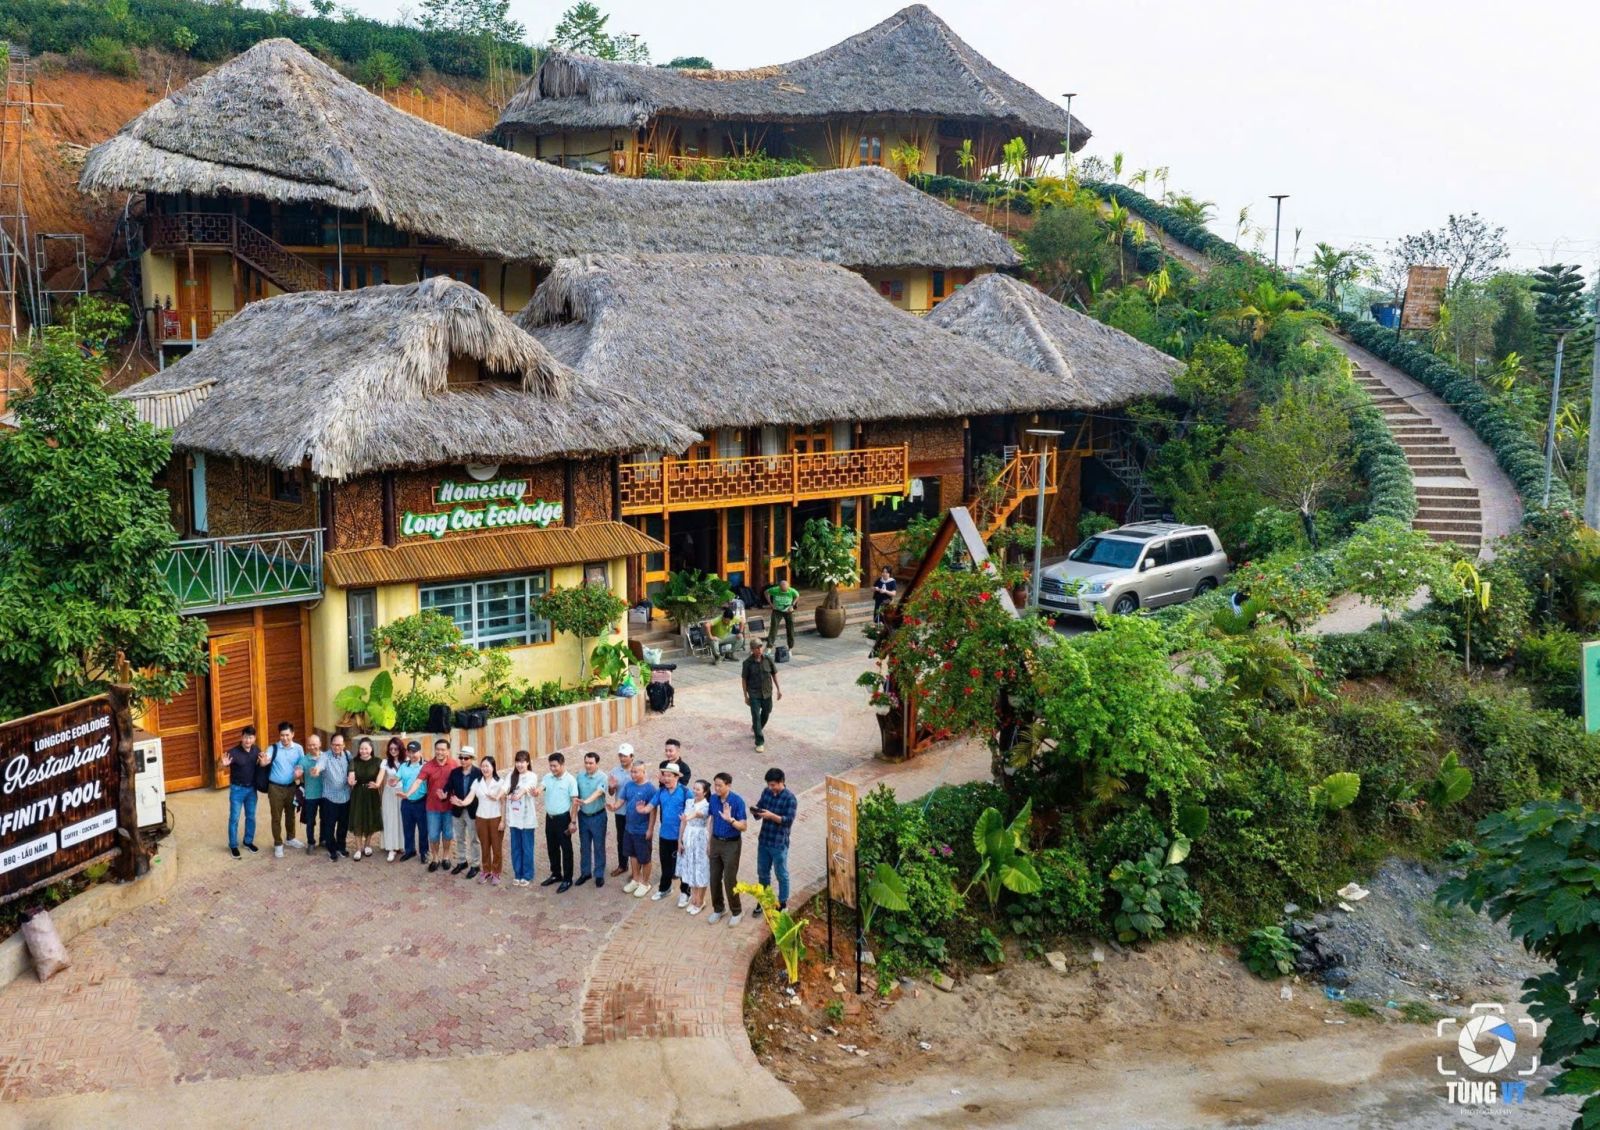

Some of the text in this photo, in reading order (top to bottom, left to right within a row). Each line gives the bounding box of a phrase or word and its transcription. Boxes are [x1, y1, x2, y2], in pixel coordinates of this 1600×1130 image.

[440, 480, 526, 501] Homestay
[403, 501, 563, 536] Long Coc Ecolodge
[34, 715, 110, 752] LONGCOC ECOLODGE
[3, 734, 111, 794] Restaurant
[62, 780, 102, 812] POOL
[4, 854, 16, 866] BBQ
